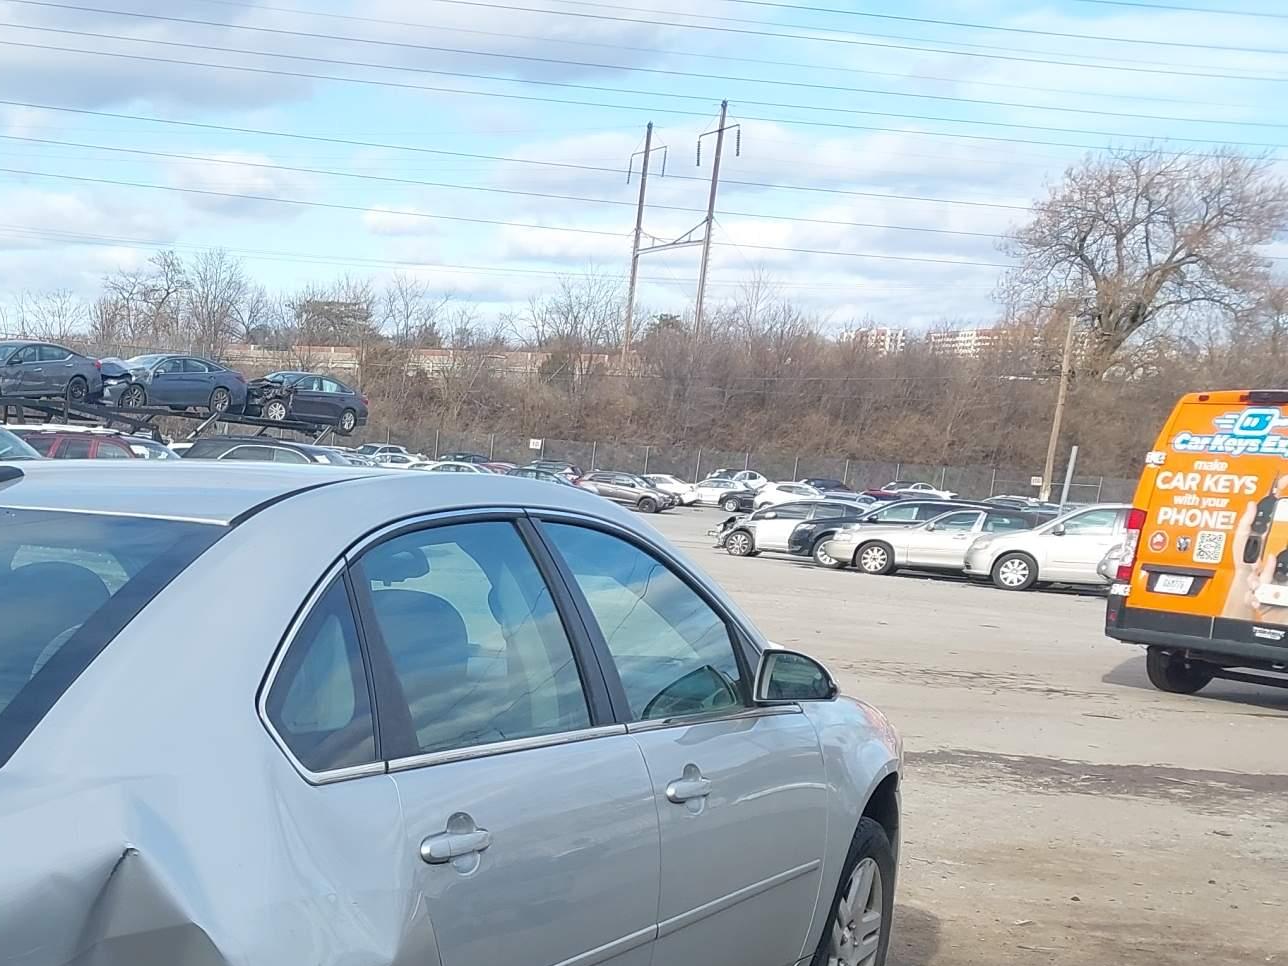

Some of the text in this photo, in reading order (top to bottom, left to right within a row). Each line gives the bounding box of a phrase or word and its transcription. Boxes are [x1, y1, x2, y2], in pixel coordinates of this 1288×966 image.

[1173, 433, 1211, 451] Car
[1209, 434, 1262, 455] Keys
[1194, 460, 1229, 472] make
[1155, 471, 1259, 495] CAR KEYS
[1173, 493, 1231, 509] with your
[1156, 507, 1238, 530] PHONE!
